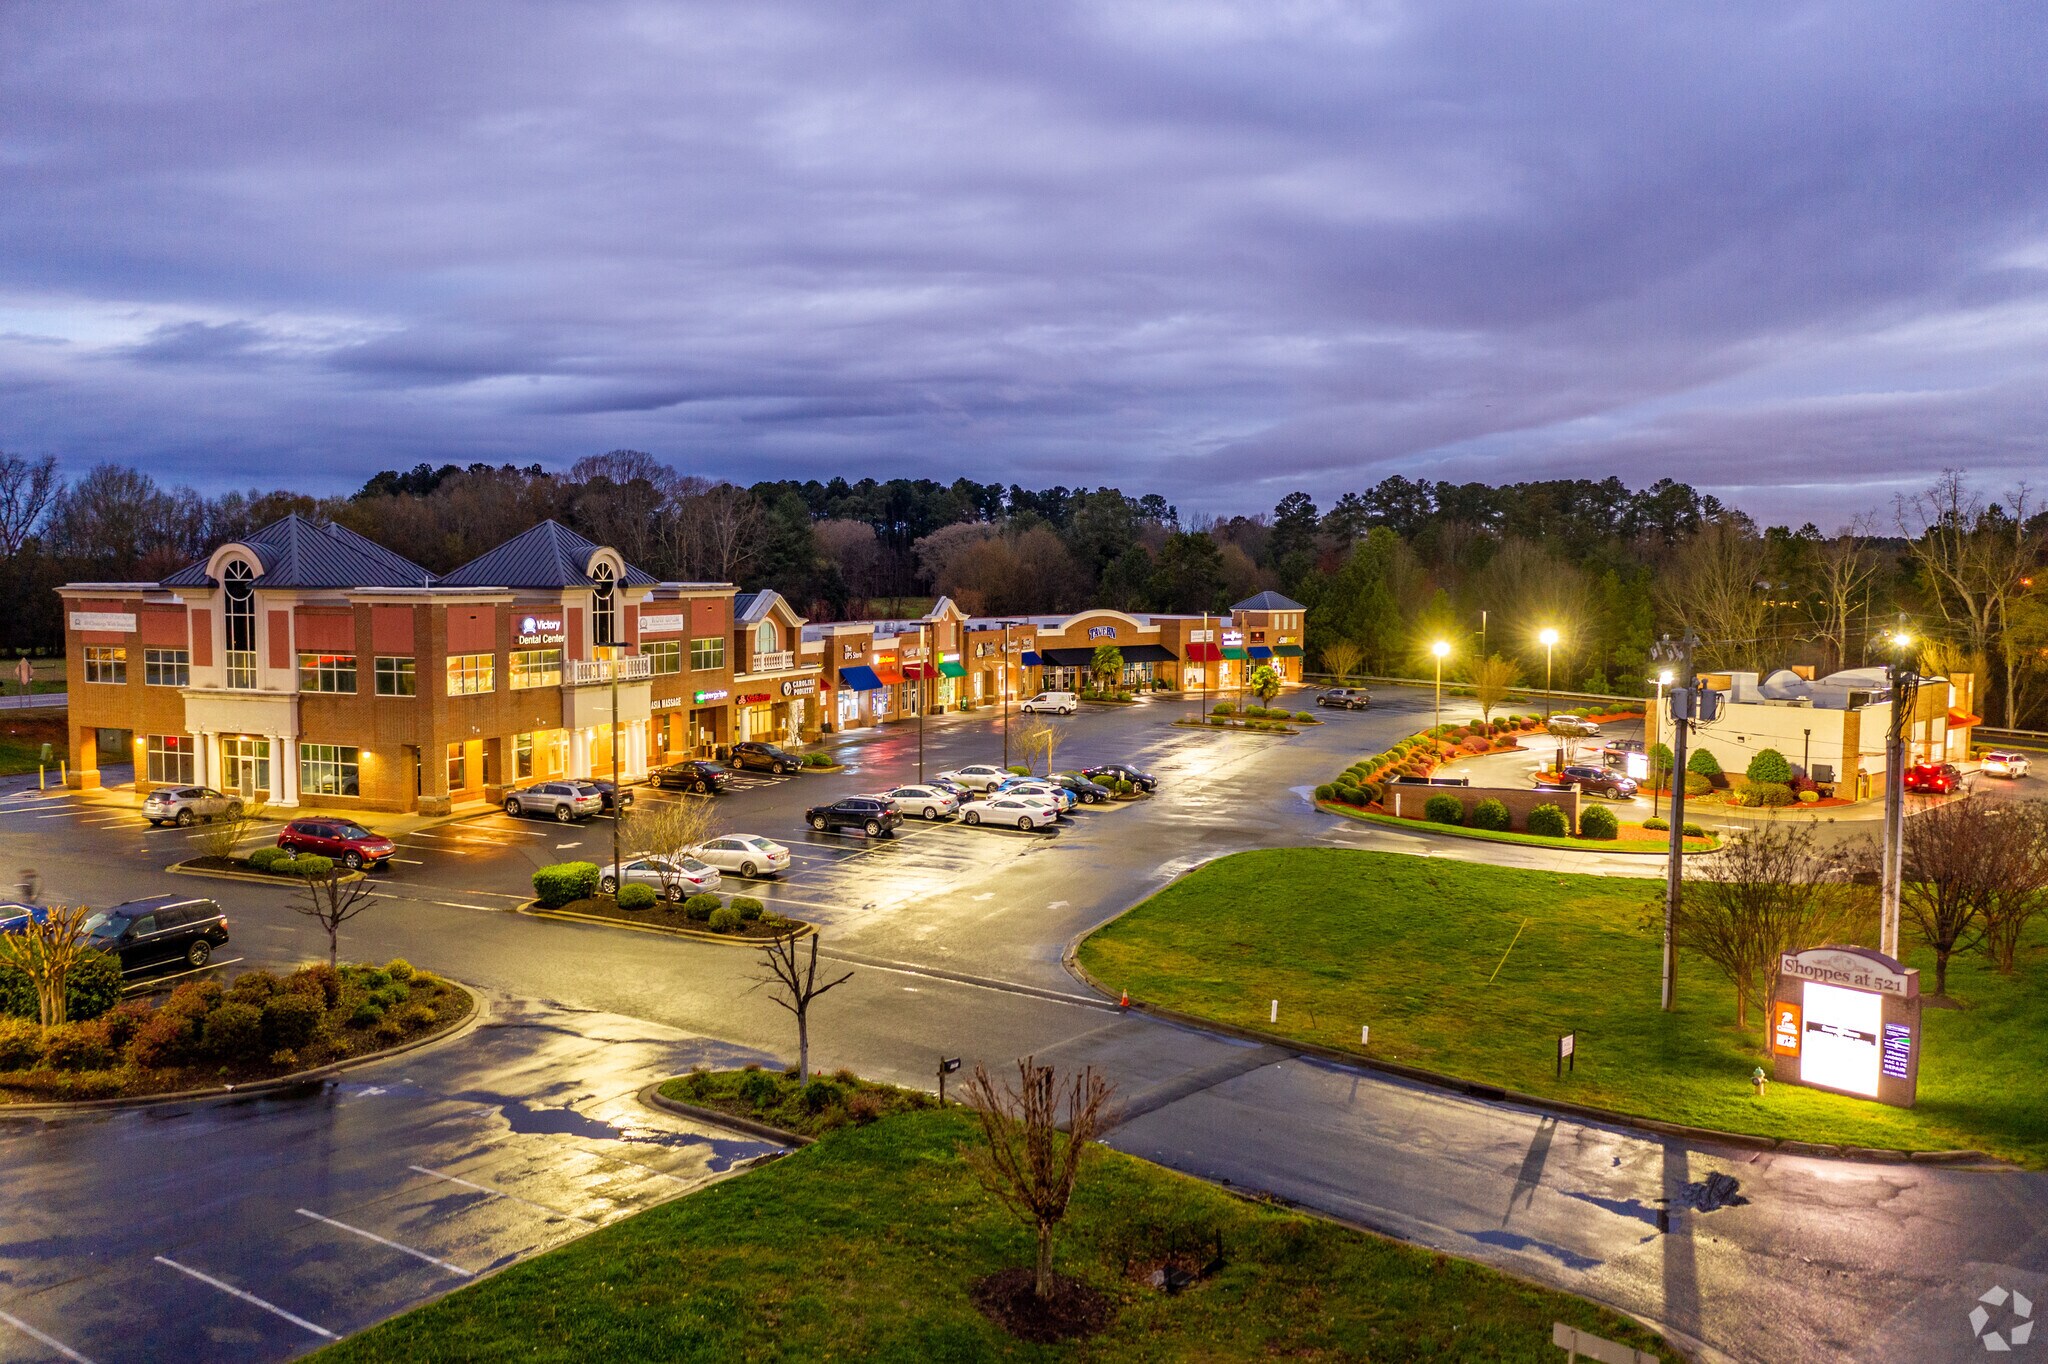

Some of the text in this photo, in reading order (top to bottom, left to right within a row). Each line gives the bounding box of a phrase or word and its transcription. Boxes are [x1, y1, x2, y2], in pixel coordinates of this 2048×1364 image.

[536, 620, 561, 631] Victory
[1088, 625, 1117, 641] TAVERN
[519, 634, 565, 645] Dental Center
[844, 644, 852, 652] The
[844, 651, 862, 660] UPS Store
[792, 679, 816, 688] CAROLINA
[793, 687, 814, 696] PODIATRY
[651, 697, 682, 710] ASIA MASSAGE
[1783, 958, 1903, 993] Shoppes at 521
[1884, 1064, 1906, 1073] REPAIR
